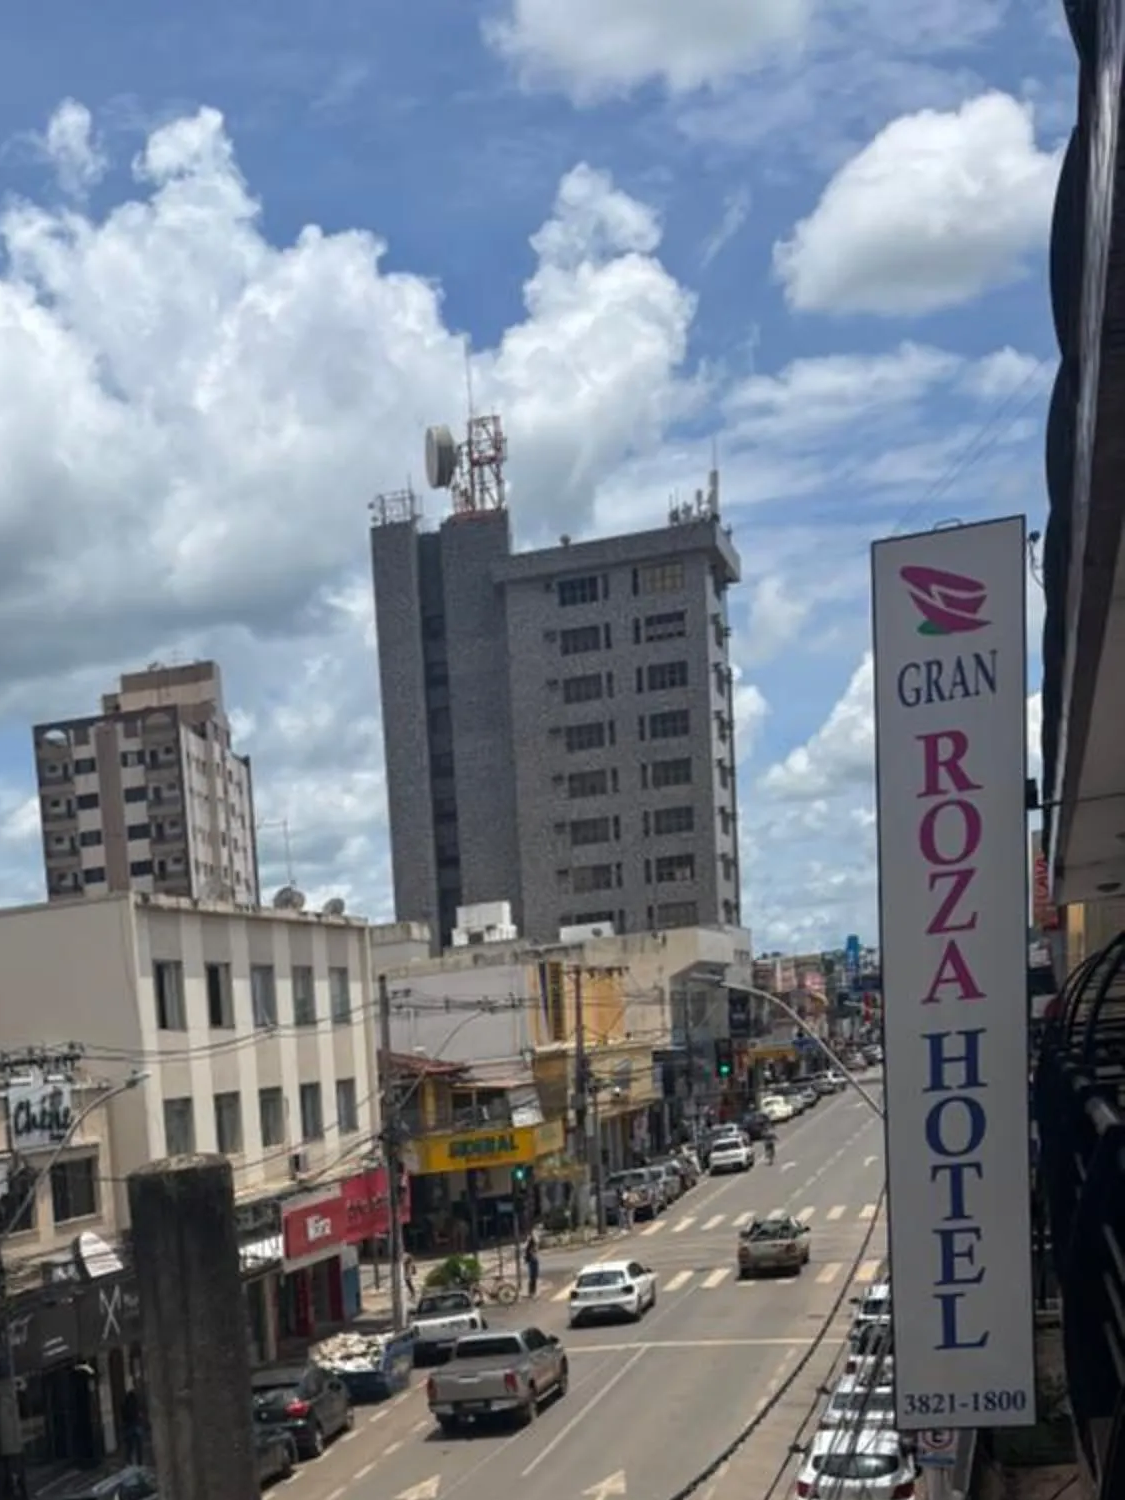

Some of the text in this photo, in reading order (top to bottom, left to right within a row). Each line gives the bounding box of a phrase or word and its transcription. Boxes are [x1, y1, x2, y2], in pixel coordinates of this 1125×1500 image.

[897, 650, 997, 708] GRAN
[915, 730, 991, 1350] ROZA HOTEL
[904, 1389, 1027, 1415] 3821-1800
